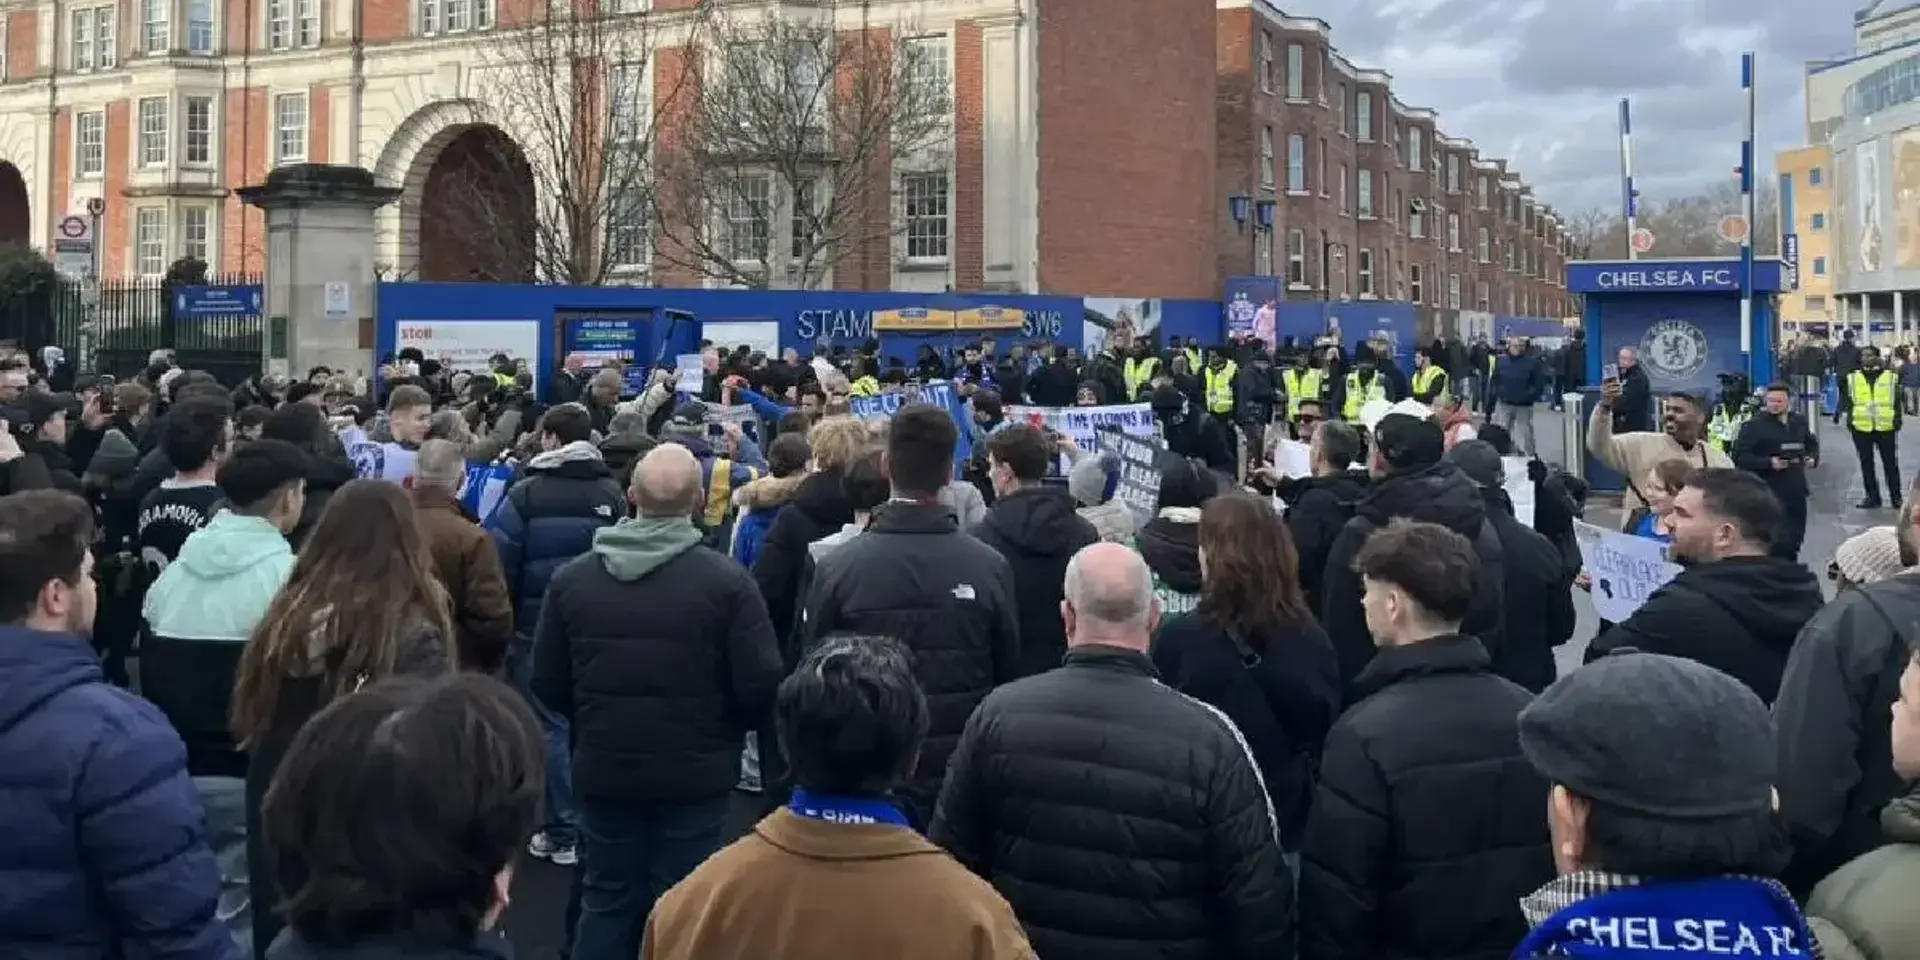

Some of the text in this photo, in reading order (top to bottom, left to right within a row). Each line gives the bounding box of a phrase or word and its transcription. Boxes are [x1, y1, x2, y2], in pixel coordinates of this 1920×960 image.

[1597, 270, 1731, 288] CHELSEA FC
[798, 309, 877, 339] STAM
[1022, 309, 1062, 338] SW6
[1566, 916, 1761, 956] CHELSEA
